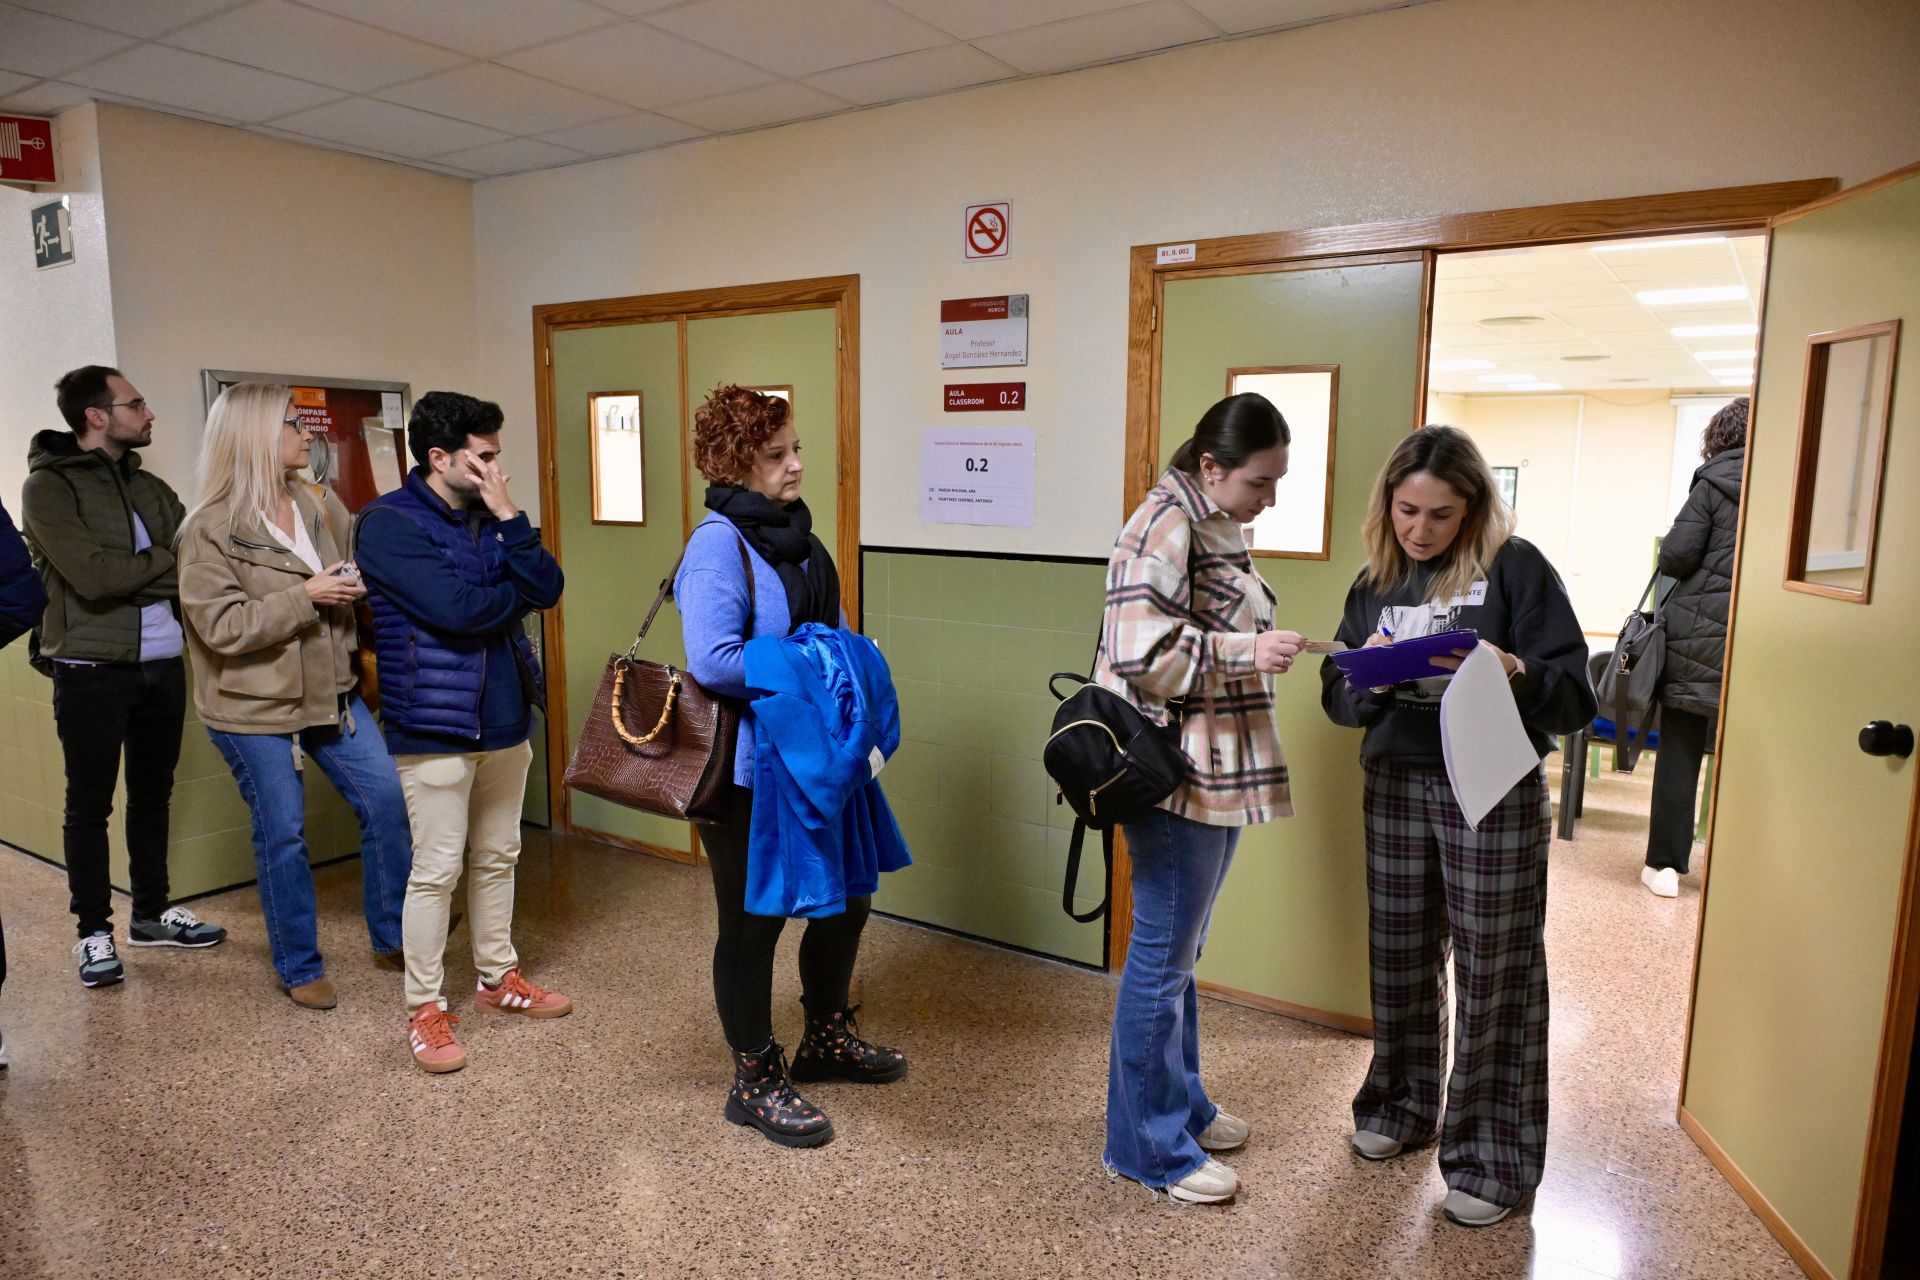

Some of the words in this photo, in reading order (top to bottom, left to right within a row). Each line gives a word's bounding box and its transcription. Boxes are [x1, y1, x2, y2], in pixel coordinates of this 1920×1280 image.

[945, 328, 963, 336] AULA
[970, 340, 996, 348] Profesor
[1000, 390, 1019, 404] 0.2
[949, 398, 985, 406] CLASSROOM
[300, 416, 321, 424] CASO
[322, 417, 333, 425] DE
[304, 424, 329, 432] ENDIO
[966, 457, 988, 472] 0.2
